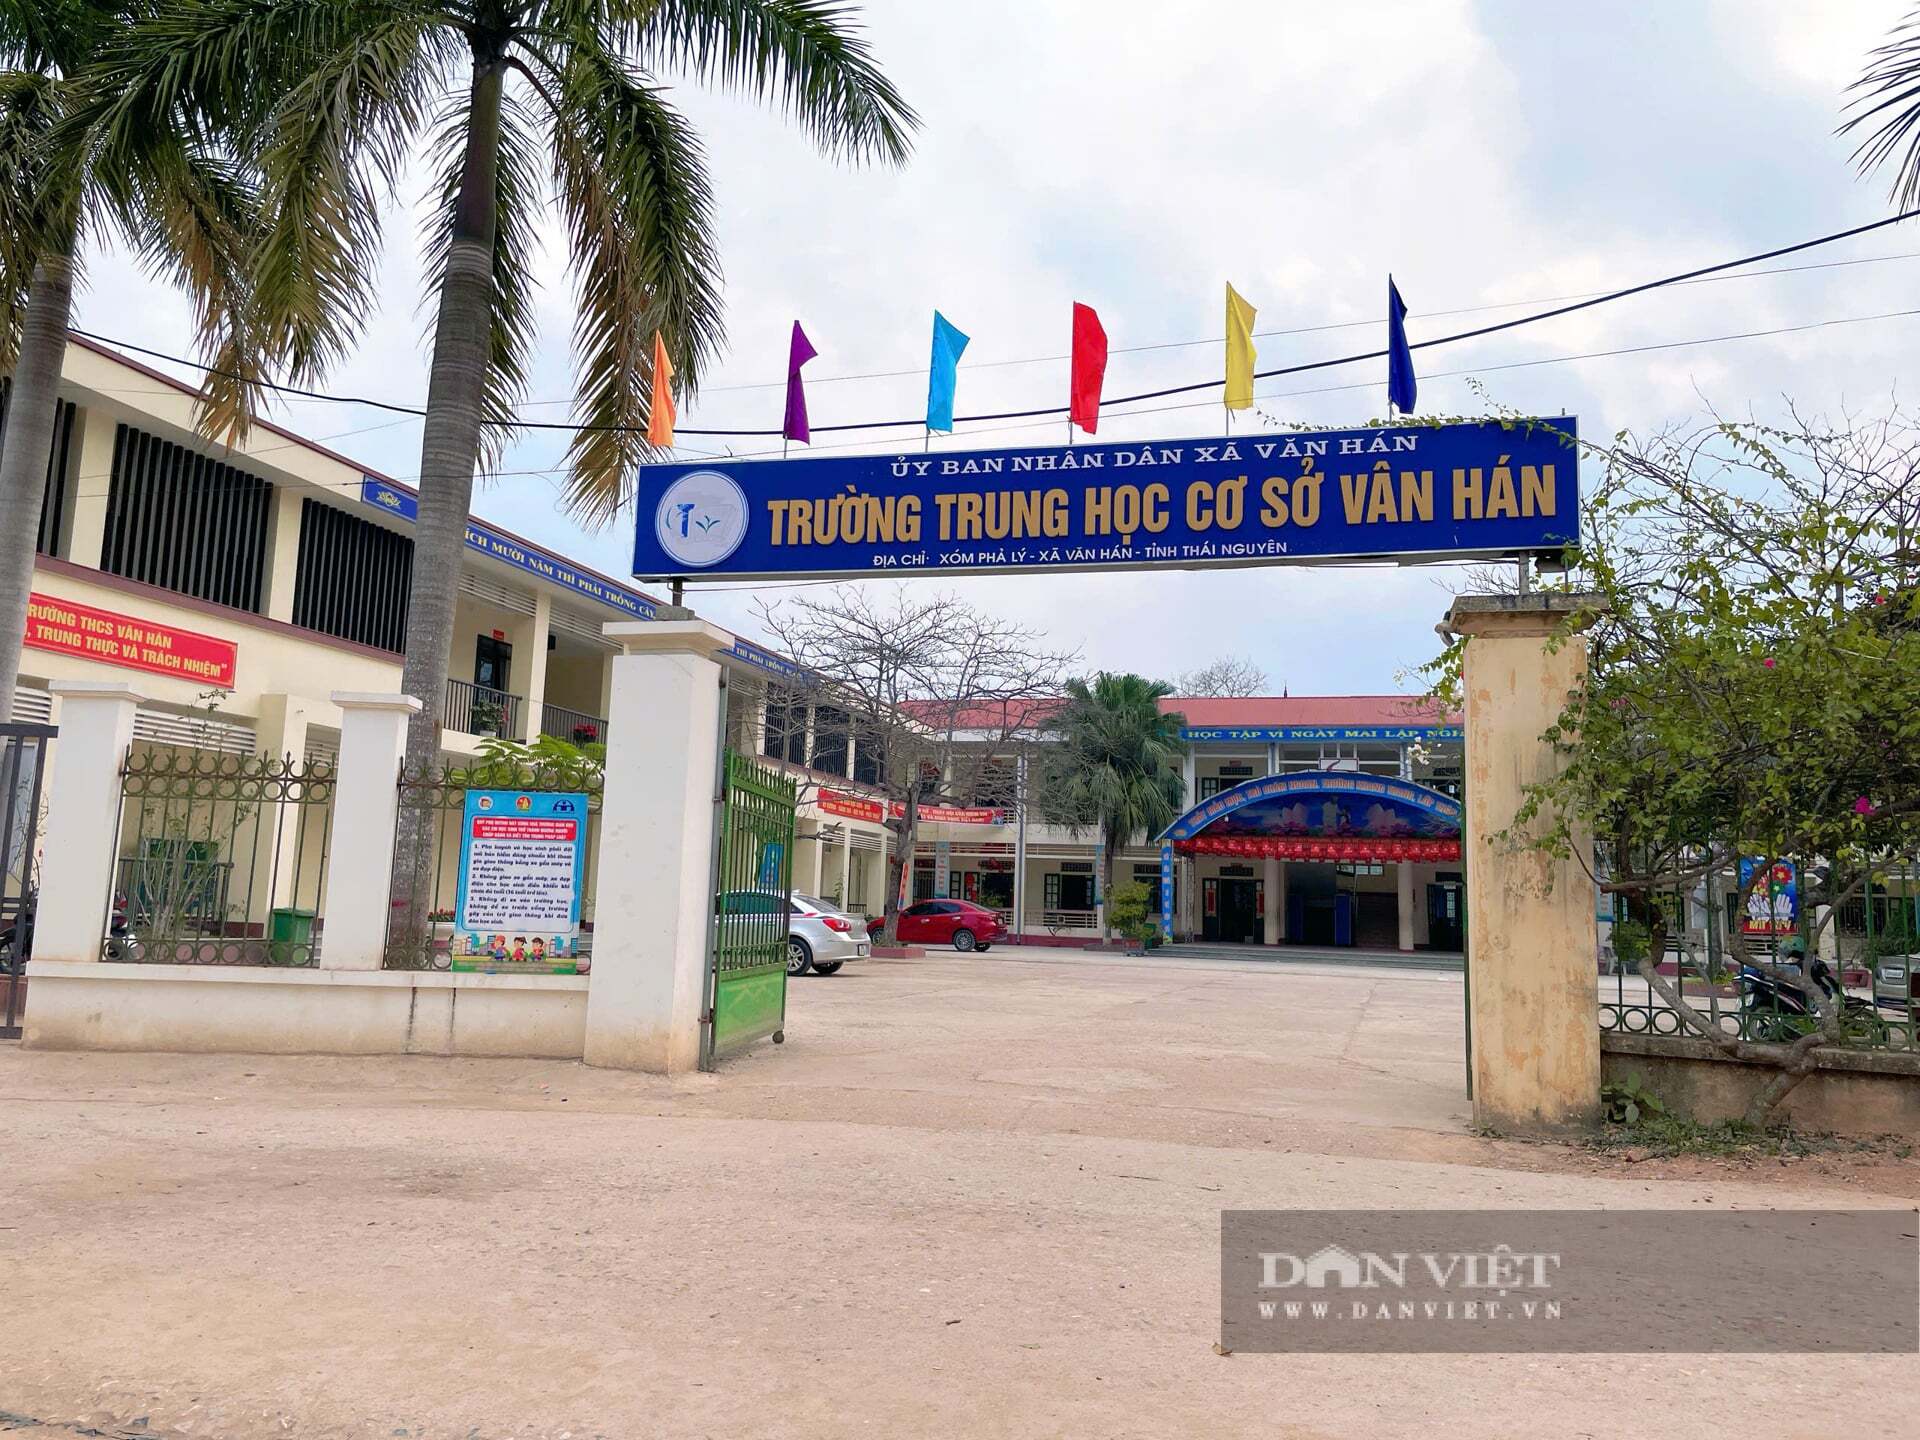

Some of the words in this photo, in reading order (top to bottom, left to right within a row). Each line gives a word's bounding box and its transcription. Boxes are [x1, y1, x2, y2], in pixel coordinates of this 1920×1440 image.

[891, 456, 933, 477] ỦY
[941, 458, 1002, 475] BAN
[1011, 451, 1105, 472] NHÂN
[1114, 444, 1184, 467] DÂN
[1194, 440, 1243, 463] XÃ
[1340, 432, 1419, 455] HÁN
[767, 485, 921, 546] TRƯỜNG
[935, 487, 1069, 541] TRUNG
[1085, 483, 1170, 545] HỌC
[1185, 476, 1248, 530] CƠ
[1260, 457, 1325, 528] SỞ
[1339, 461, 1434, 525] VÂN
[1452, 455, 1556, 520] HÁN
[873, 554, 897, 567] ĐỊA
[940, 548, 976, 565] XÓM
[978, 548, 1007, 564] PHẢ
[1012, 549, 1027, 562] LÝ
[1039, 547, 1061, 561] XÃ
[1100, 543, 1132, 560] HÁN
[1145, 540, 1179, 558] TỈNH
[1182, 541, 1216, 557] THÁI
[1221, 540, 1287, 556] NGUYÊN
[27, 602, 76, 628] RƯỜNG
[80, 616, 113, 634] THCS
[145, 631, 173, 649] HÁN
[37, 625, 82, 646] TRUNG
[85, 637, 119, 656] THỰC
[122, 644, 139, 660] VÀ
[142, 648, 181, 669] TRÁCH
[1188, 731, 1222, 740] HỌC
[1230, 730, 1261, 740] TẬP
[1291, 728, 1341, 738] NGÀY
[1345, 730, 1377, 738] MAI
